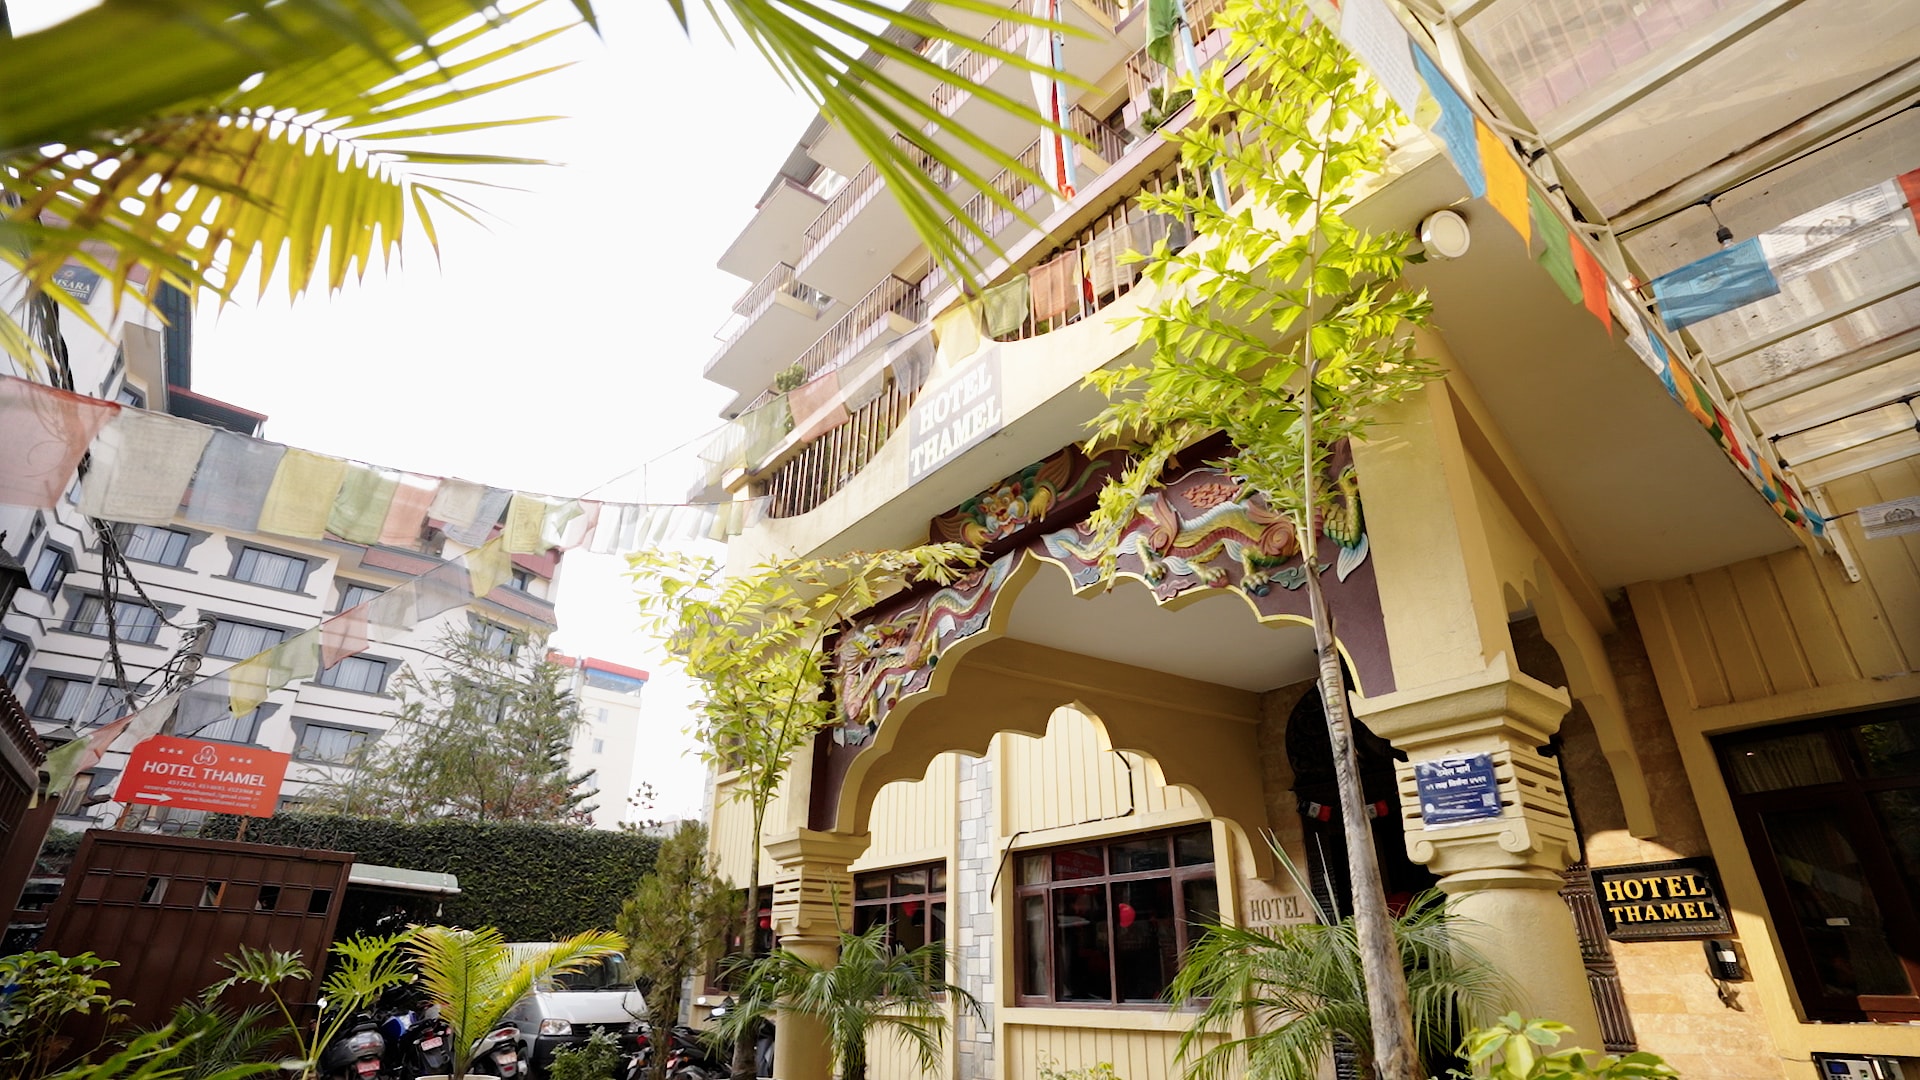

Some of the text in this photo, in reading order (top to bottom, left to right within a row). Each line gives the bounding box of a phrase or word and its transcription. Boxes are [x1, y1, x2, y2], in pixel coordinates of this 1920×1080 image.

[918, 362, 993, 436] HOTEL
[910, 395, 1001, 477] THAMEL
[142, 760, 267, 787] HOTEL THAMEL
[1602, 874, 1707, 902] HOTEL
[1250, 895, 1304, 922] HOTEL
[1608, 901, 1714, 923] THAMEL
